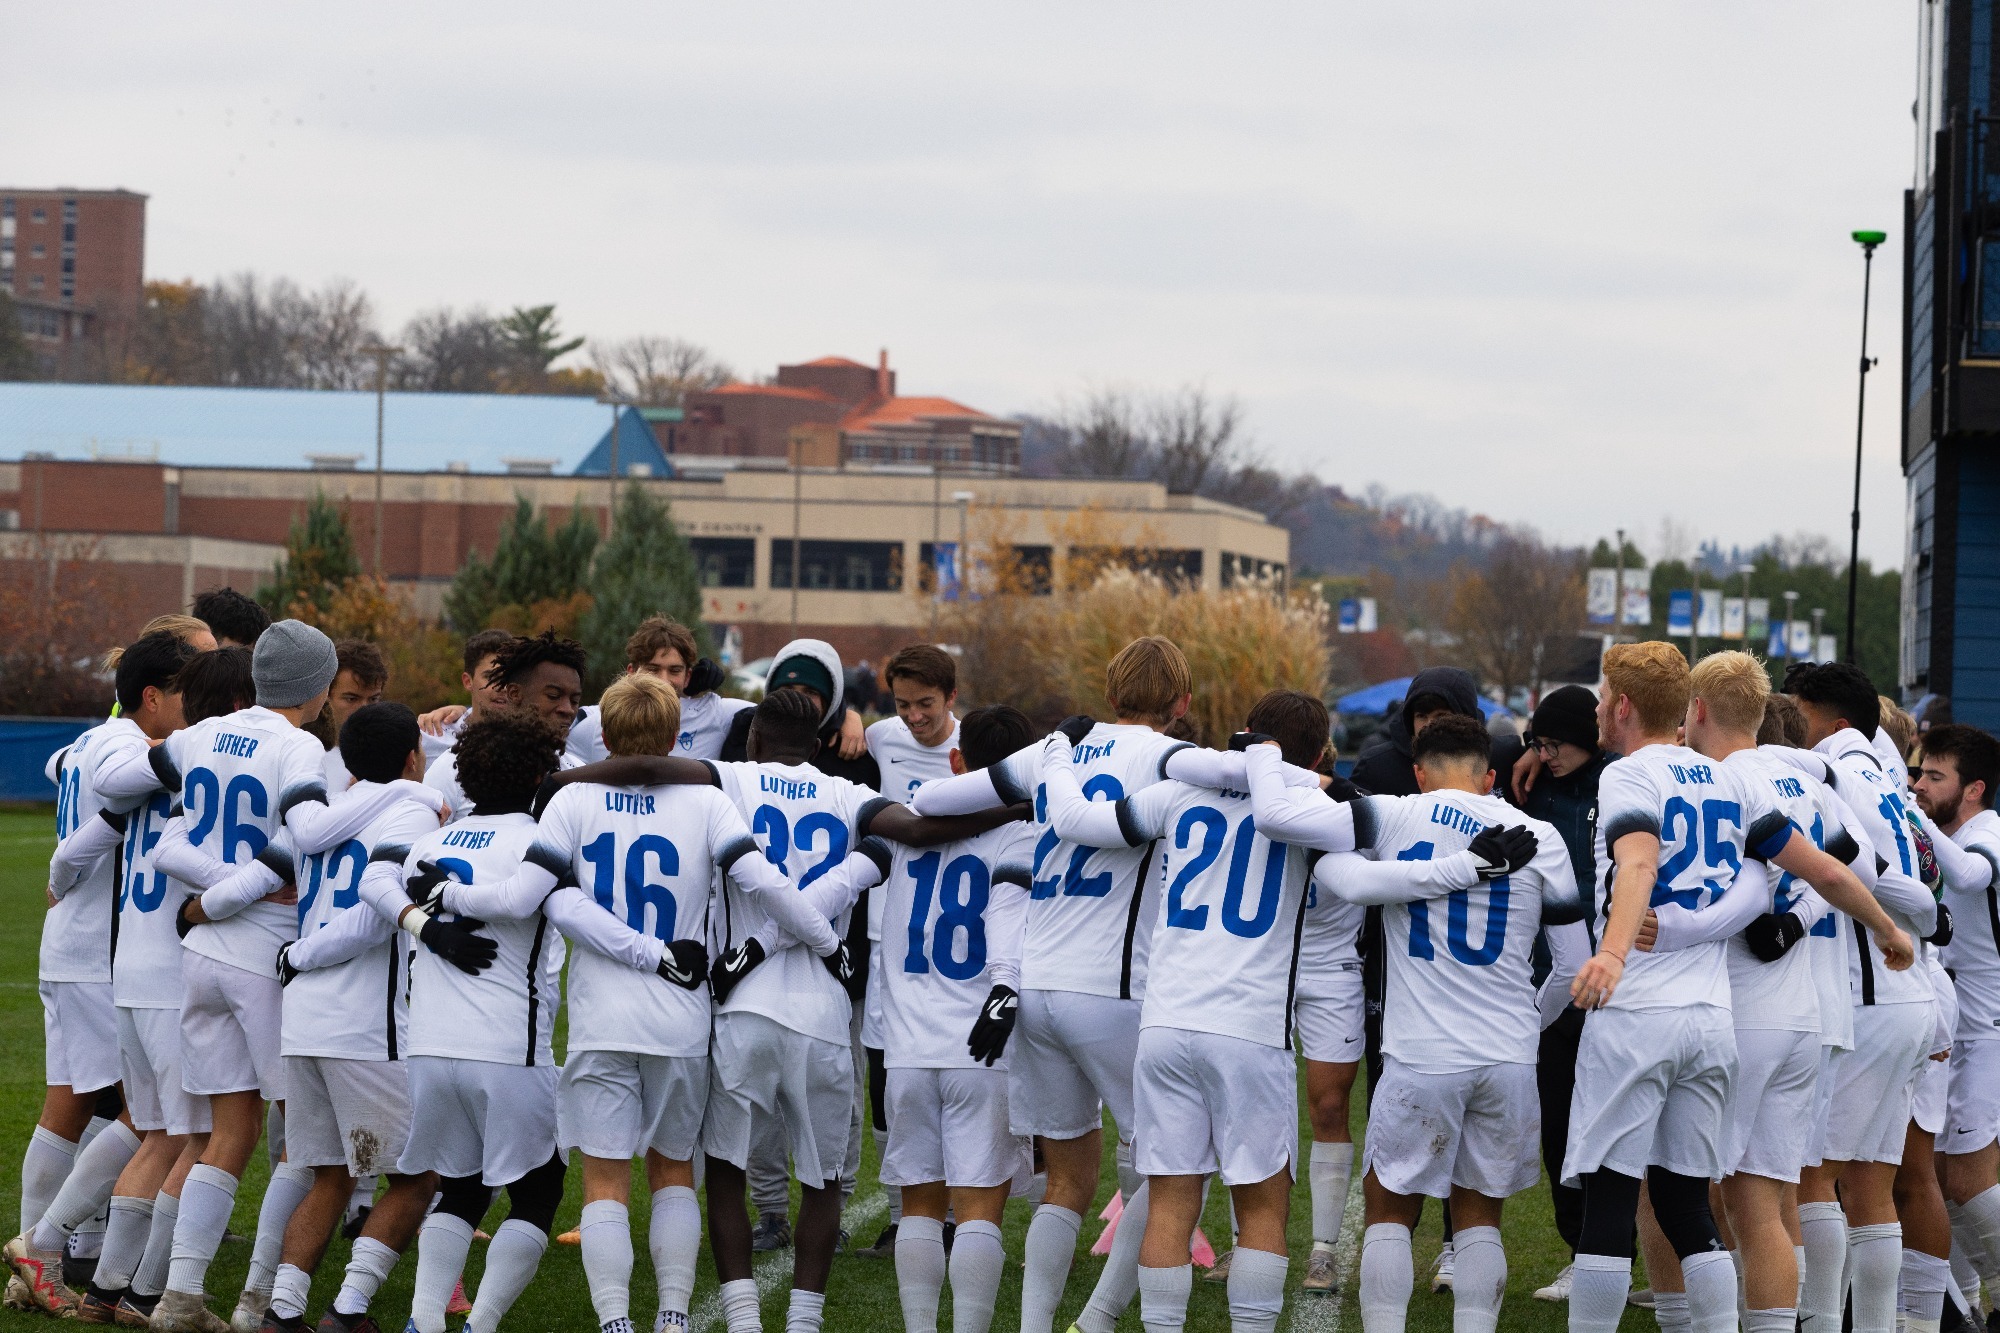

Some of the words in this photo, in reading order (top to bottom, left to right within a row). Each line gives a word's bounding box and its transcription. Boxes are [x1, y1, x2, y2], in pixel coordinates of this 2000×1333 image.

[213, 733, 258, 758] LUTHER
[760, 775, 816, 800] LUTHER
[184, 767, 268, 864] 26
[442, 830, 495, 849] LUTHER
[605, 792, 656, 815] LUTHER
[1431, 803, 1488, 838] LUTHE
[582, 831, 679, 943] 16
[1167, 806, 1287, 938] 20
[1649, 796, 1742, 910] 25
[904, 852, 990, 980] 18
[1397, 841, 1510, 966] 10
